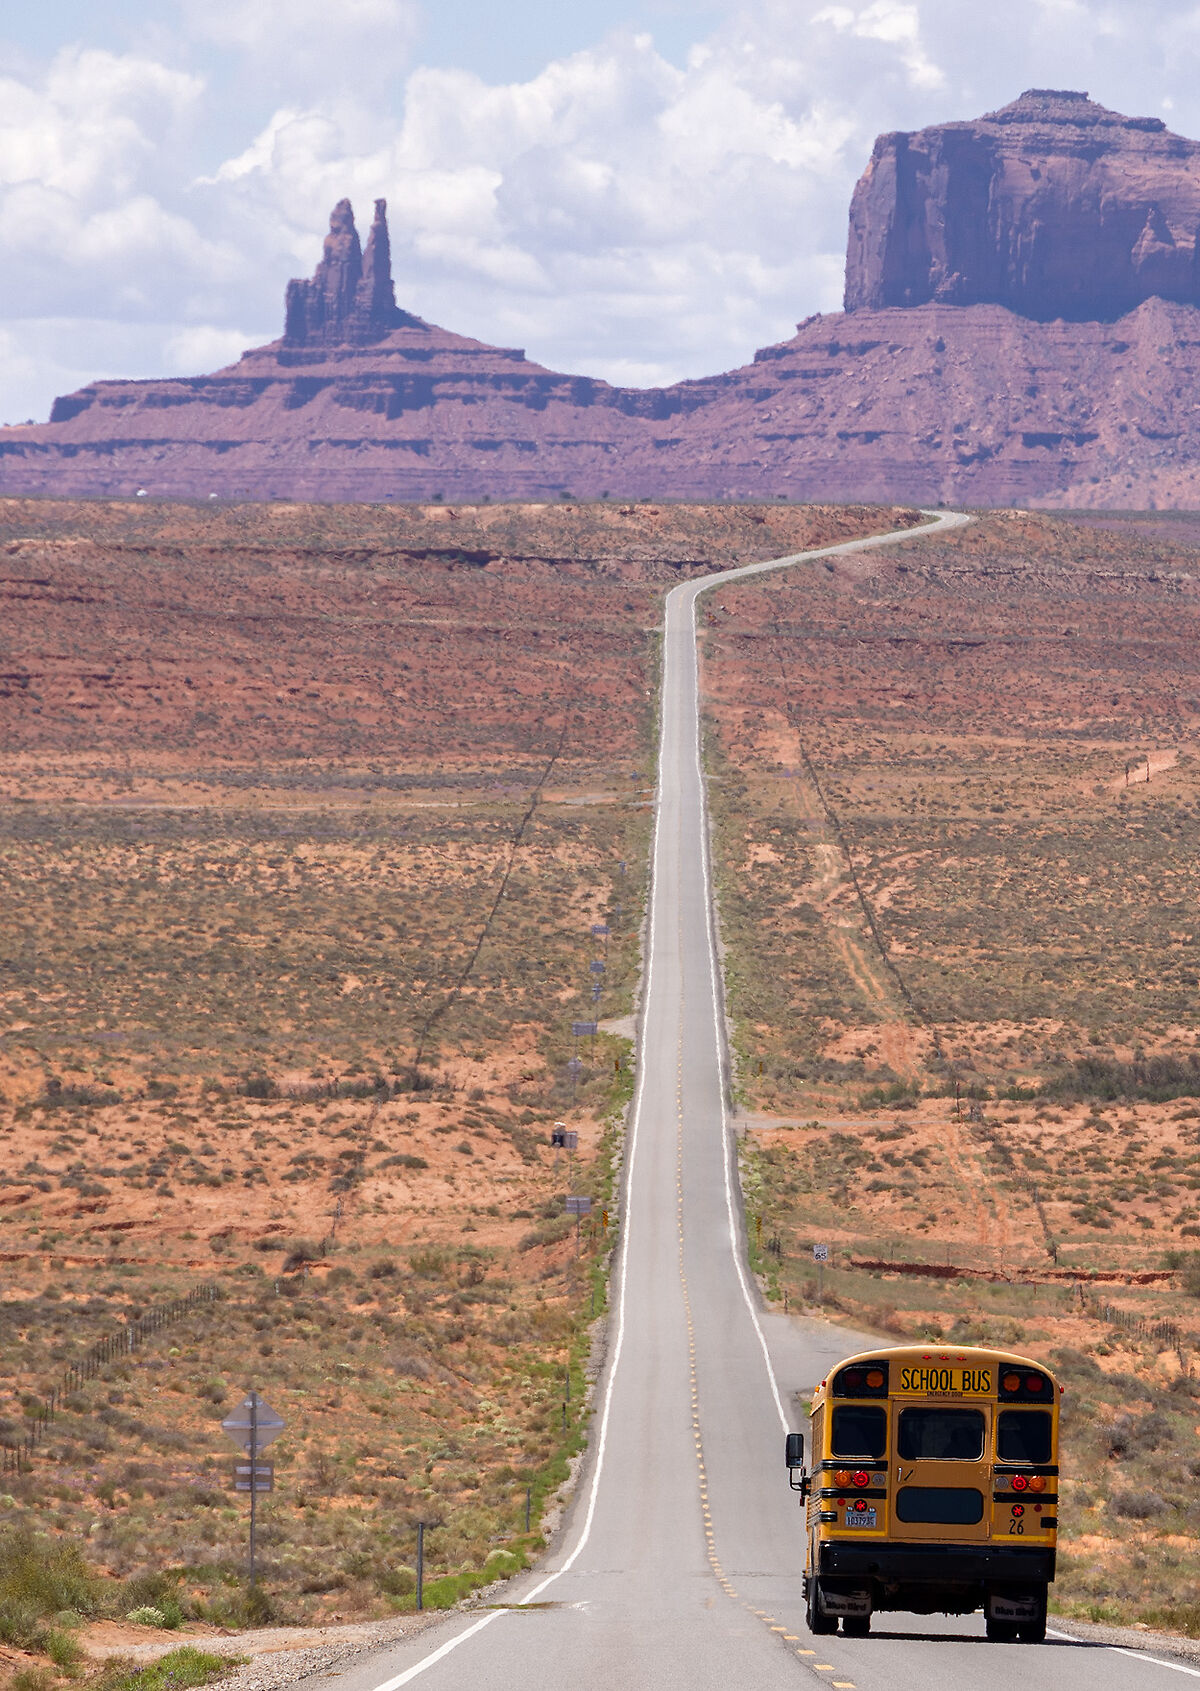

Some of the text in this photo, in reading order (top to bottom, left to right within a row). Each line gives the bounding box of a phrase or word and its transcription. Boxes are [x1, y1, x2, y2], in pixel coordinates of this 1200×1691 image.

[815, 1252, 827, 1260] 65
[901, 1368, 991, 1392] SCHOOL BUS
[1009, 1518, 1024, 1535] 26
[826, 1601, 867, 1611] Blue Bird
